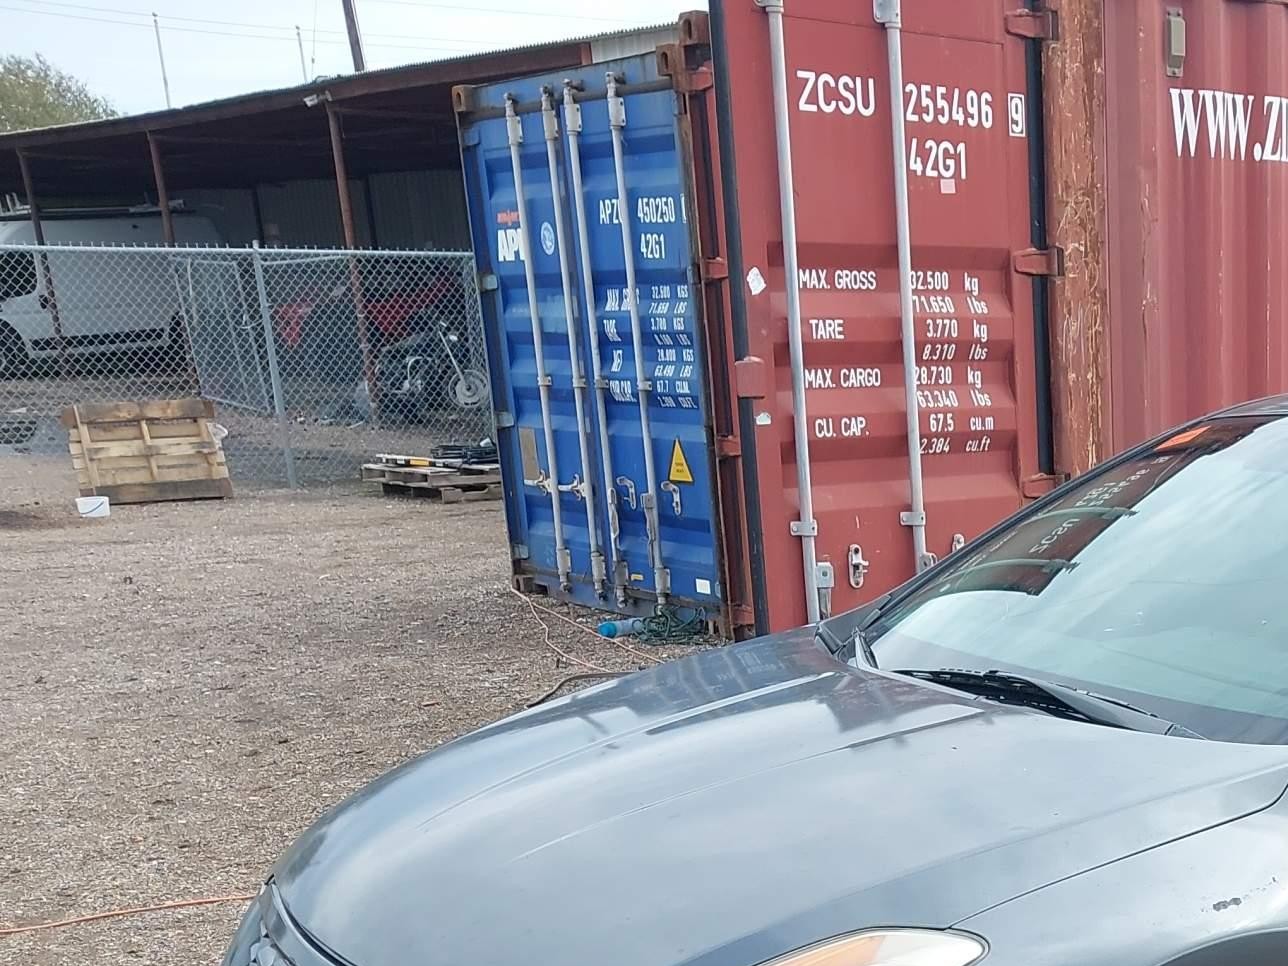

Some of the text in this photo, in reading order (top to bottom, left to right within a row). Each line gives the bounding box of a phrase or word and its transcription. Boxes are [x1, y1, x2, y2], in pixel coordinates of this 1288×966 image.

[797, 70, 1024, 135] ZCSU 255496 9
[909, 138, 966, 179] 42G1
[638, 197, 675, 223] 450250
[641, 233, 665, 259] 42G1
[799, 269, 830, 289] MAX.
[835, 270, 876, 290] GROSS
[964, 273, 979, 295] kg
[912, 296, 988, 314] 71.650 lbs
[810, 319, 988, 342] TARE 3.770 kg
[923, 344, 988, 360] 8.310 lbs
[805, 367, 981, 388] MAX. CARGO 28.730 kg
[917, 391, 992, 408] 63.340 lbs
[815, 413, 994, 438] CU. CAP. 67.5 cu.m
